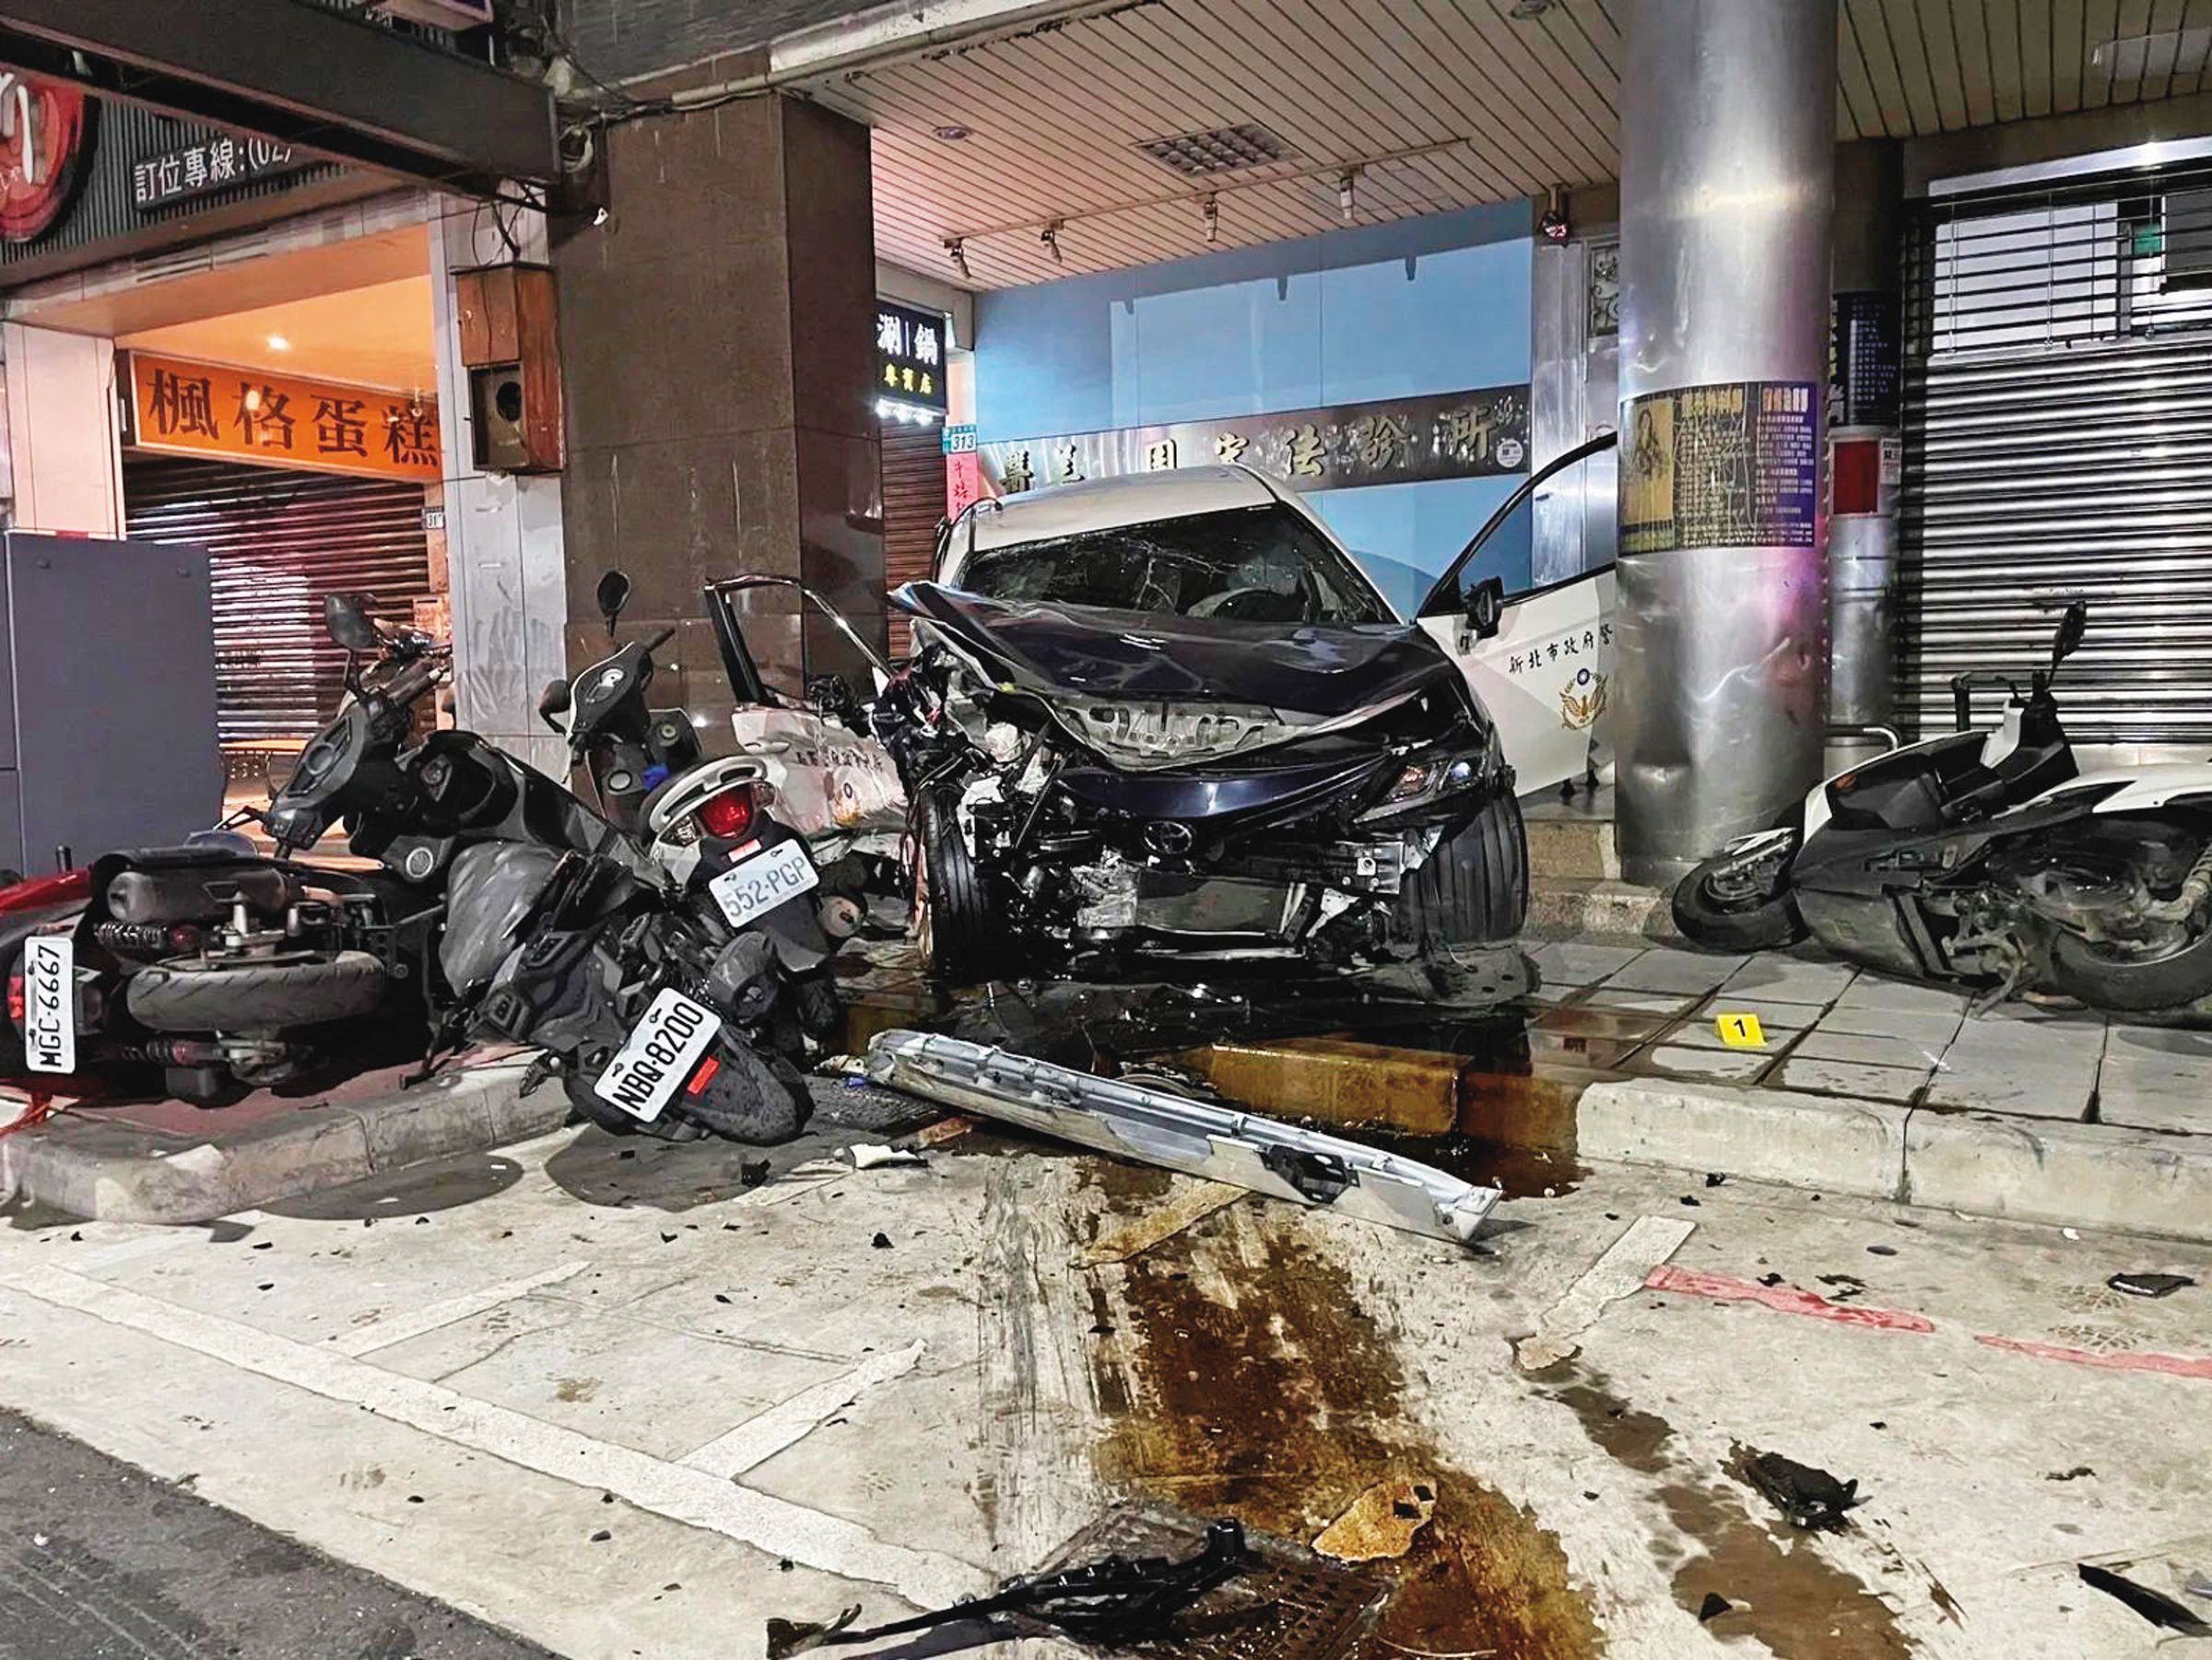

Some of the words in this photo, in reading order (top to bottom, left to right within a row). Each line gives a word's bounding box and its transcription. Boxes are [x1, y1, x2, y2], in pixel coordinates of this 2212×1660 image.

[145, 368, 439, 467] 楓格蛋糕
[953, 434, 975, 451] 313
[1734, 1018, 1746, 1037] 1
